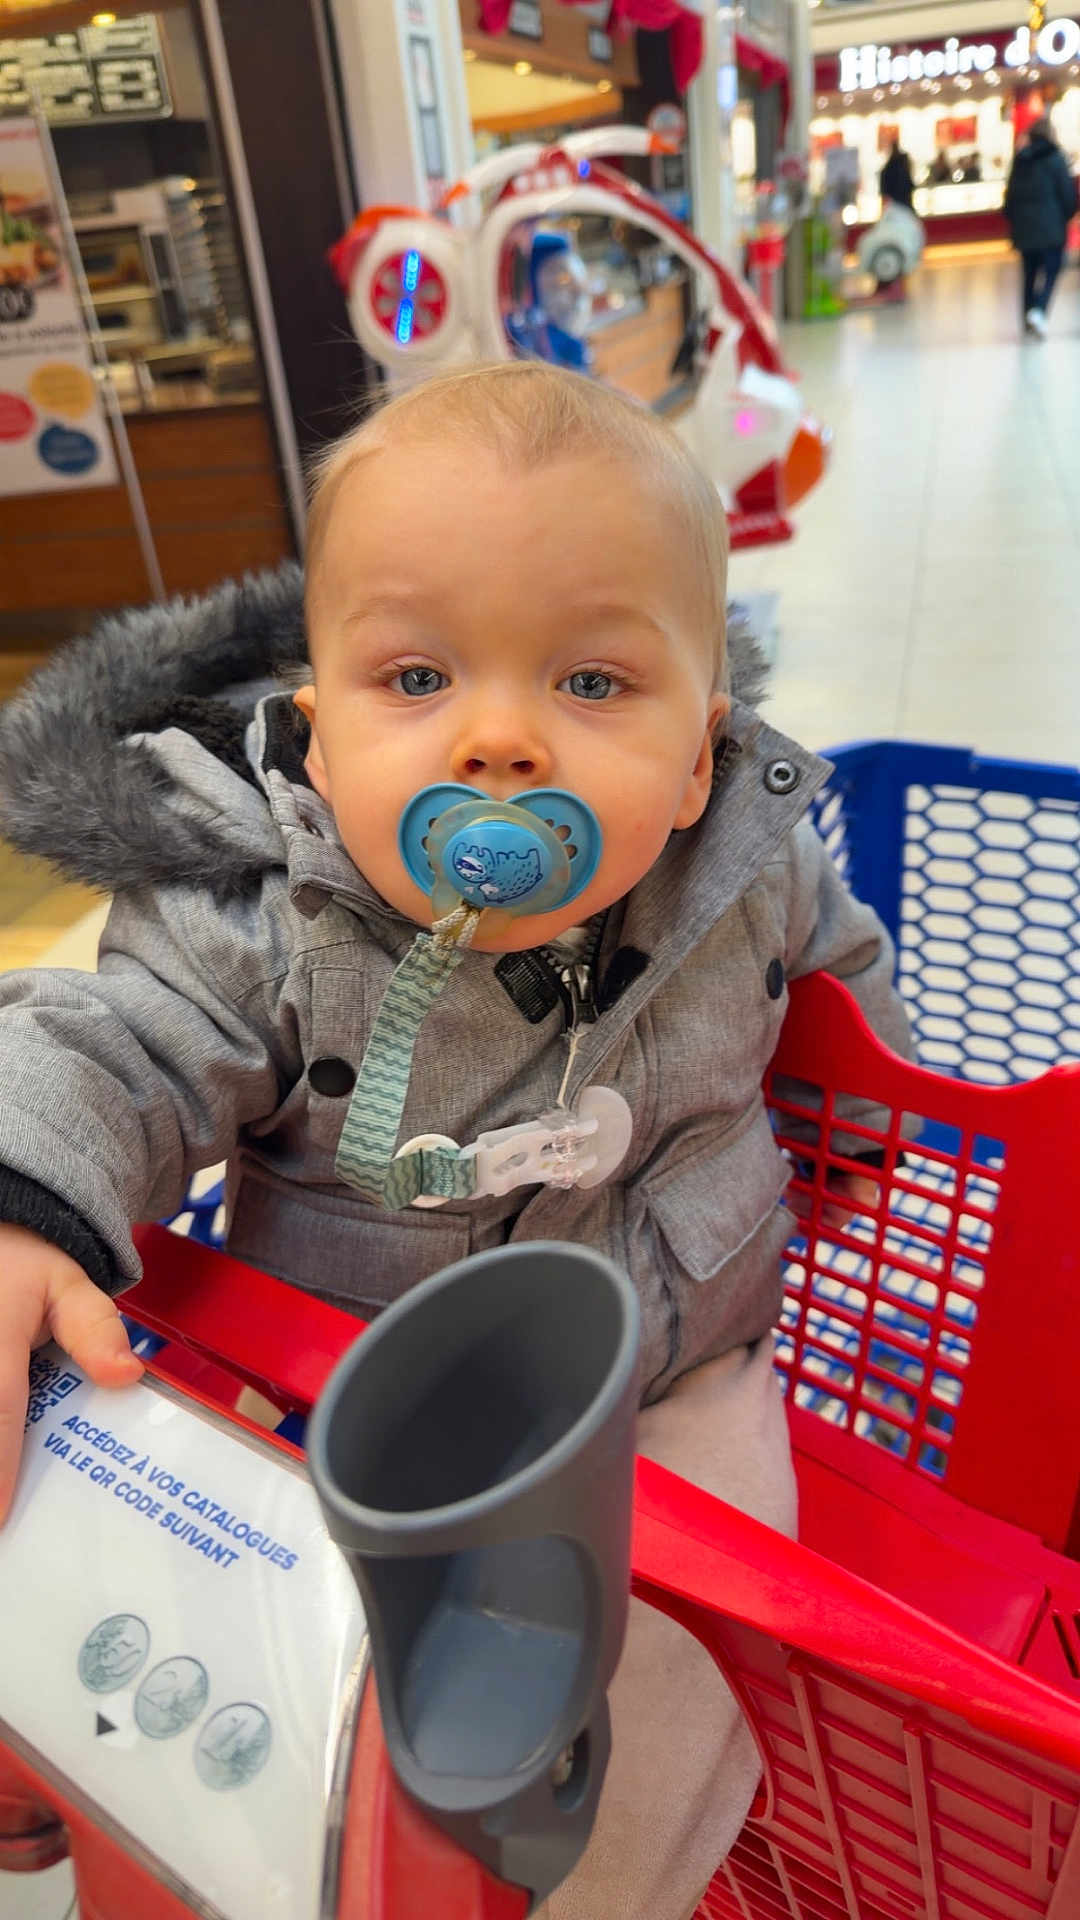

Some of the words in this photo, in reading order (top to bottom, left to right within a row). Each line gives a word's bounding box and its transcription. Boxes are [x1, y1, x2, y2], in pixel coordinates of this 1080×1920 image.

[840, 37, 996, 92] Histoire
[43, 1432, 72, 1460] VIA
[68, 1451, 94, 1473] LE
[89, 1465, 118, 1489] QR
[113, 1481, 164, 1520] CODE
[158, 1511, 240, 1569] SUIVANT
[61, 1415, 137, 1466] ACCÉDEZ
[129, 1455, 151, 1476] À
[147, 1466, 185, 1498] VOS
[182, 1491, 299, 1571] CATALOGUES
